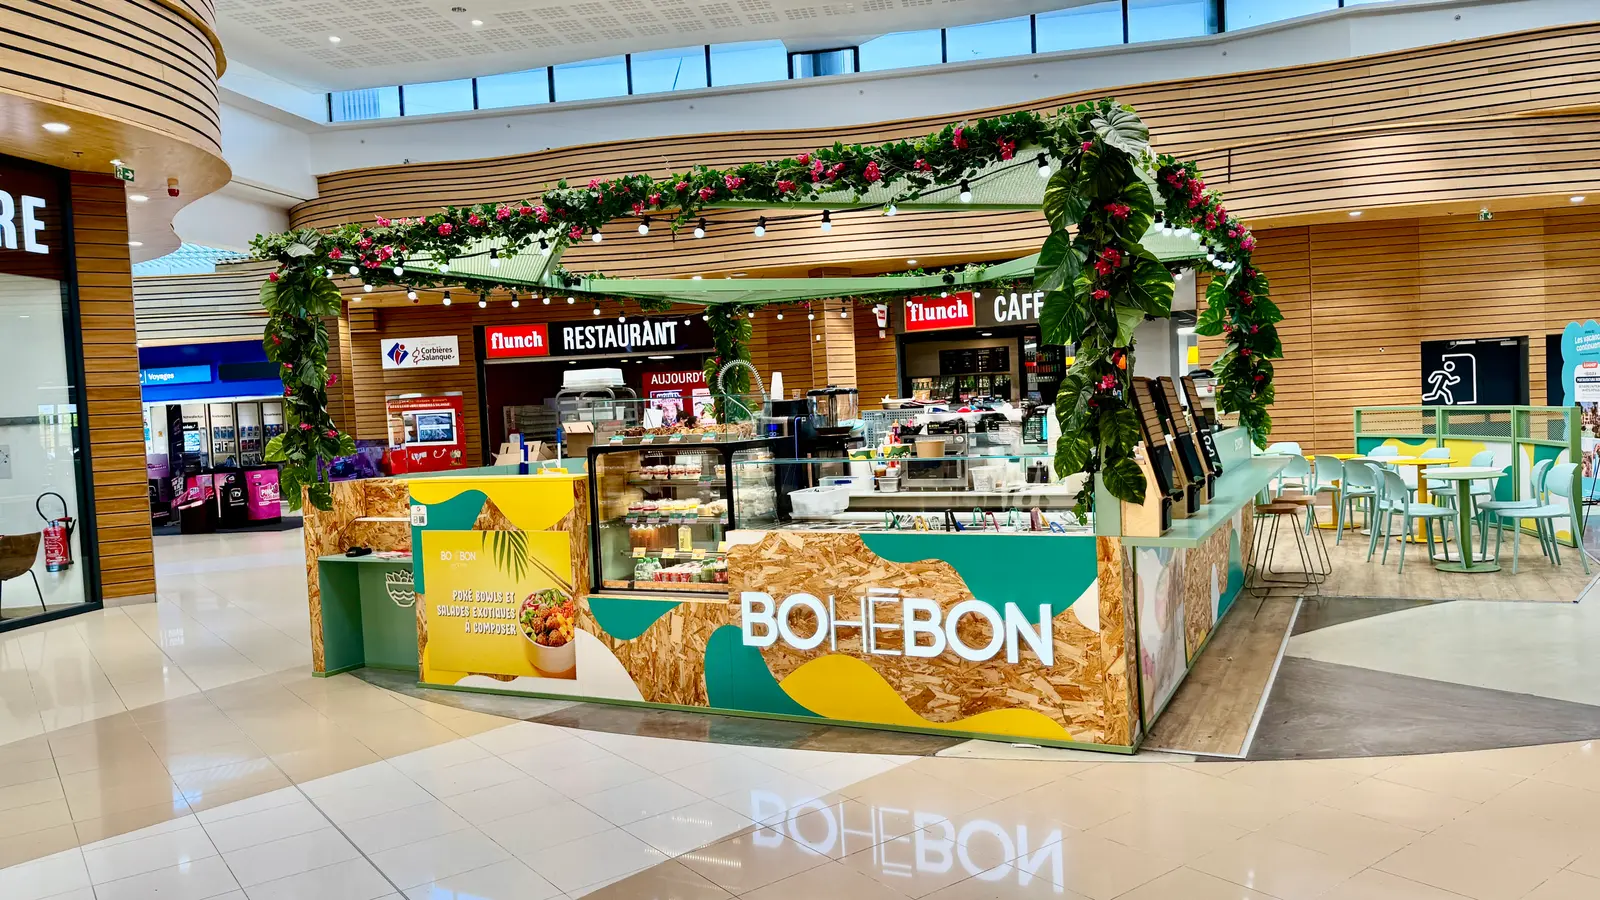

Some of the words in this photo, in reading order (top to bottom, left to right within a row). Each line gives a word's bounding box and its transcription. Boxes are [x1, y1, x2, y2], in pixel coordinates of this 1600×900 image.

[0, 189, 49, 254] RE
[910, 300, 968, 322] flunch
[994, 289, 1045, 322] CAFÉ
[491, 331, 543, 349] flunch
[563, 321, 678, 350] RESTAURANT
[421, 346, 453, 354] Corbières
[148, 373, 175, 381] Voyages
[453, 588, 473, 602] POKÉ
[475, 590, 503, 603] BOWLS
[506, 592, 516, 604] ET
[437, 605, 470, 617] SALADES
[473, 607, 516, 619] EXOTIQUES
[474, 622, 517, 636] COMPOSER
